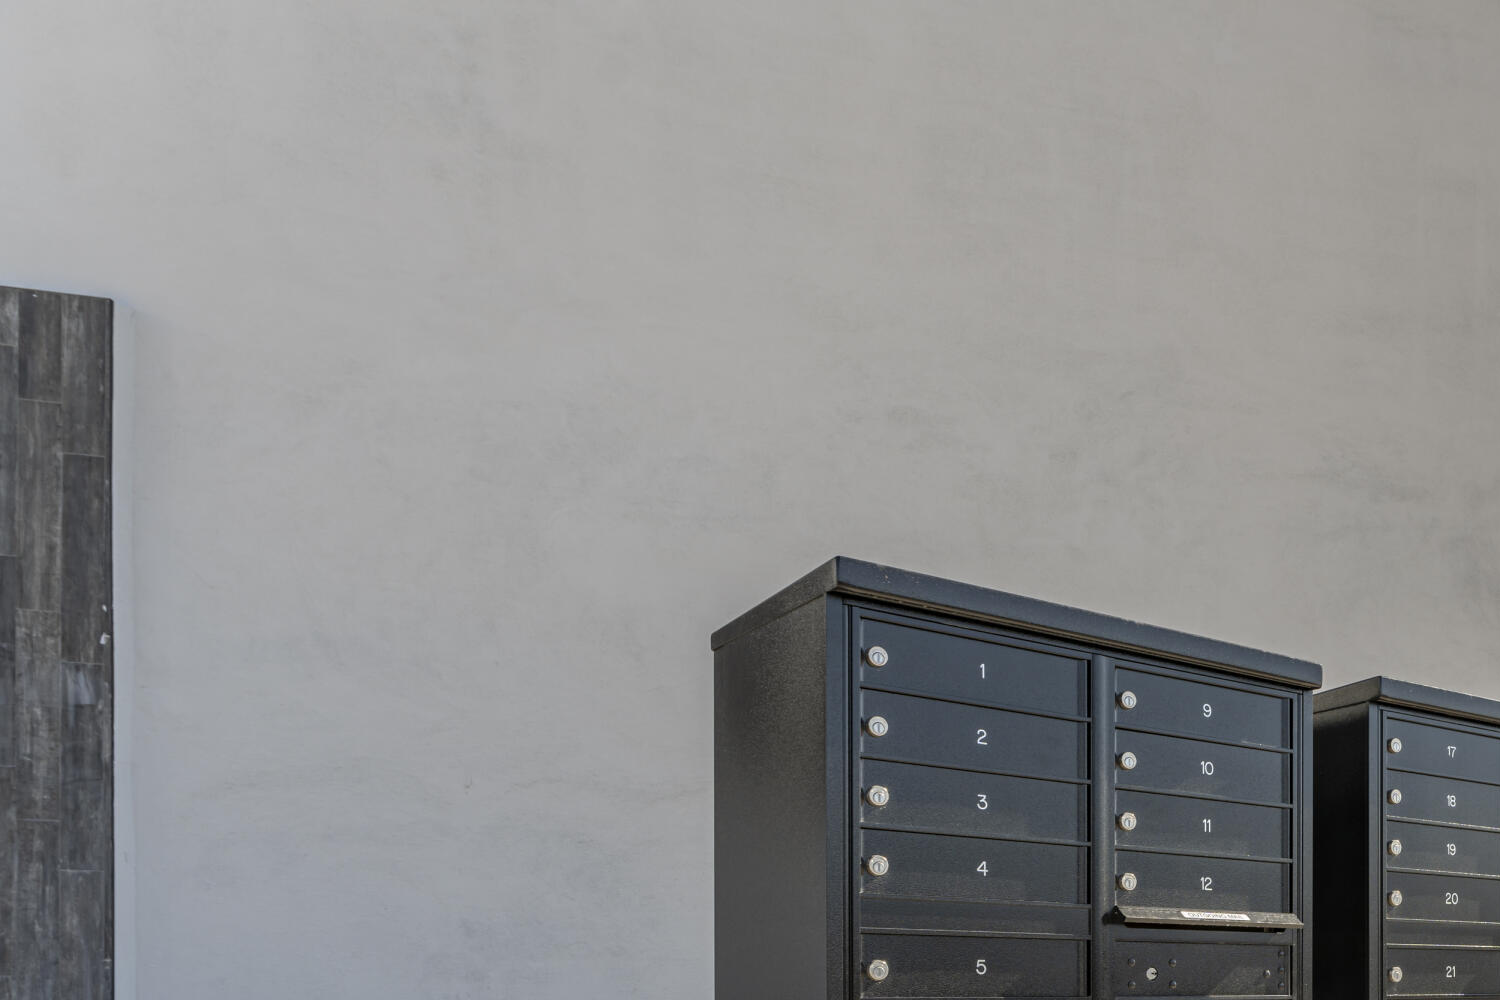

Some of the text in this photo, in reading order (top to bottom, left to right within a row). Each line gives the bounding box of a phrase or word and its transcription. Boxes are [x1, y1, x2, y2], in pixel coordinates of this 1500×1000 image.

[979, 663, 985, 679] 1
[1202, 703, 1212, 718] 9
[976, 728, 988, 746] 2
[1447, 745, 1457, 758] 17
[1200, 760, 1215, 776] 10
[976, 793, 988, 810] 3
[1446, 794, 1457, 808] 18
[1202, 818, 1212, 833] 11
[1446, 843, 1457, 856] 19
[976, 860, 989, 877] 4
[1200, 876, 1213, 891] 12
[1445, 892, 1459, 905] 20
[975, 959, 987, 976] 5
[1445, 965, 1456, 978] 21
